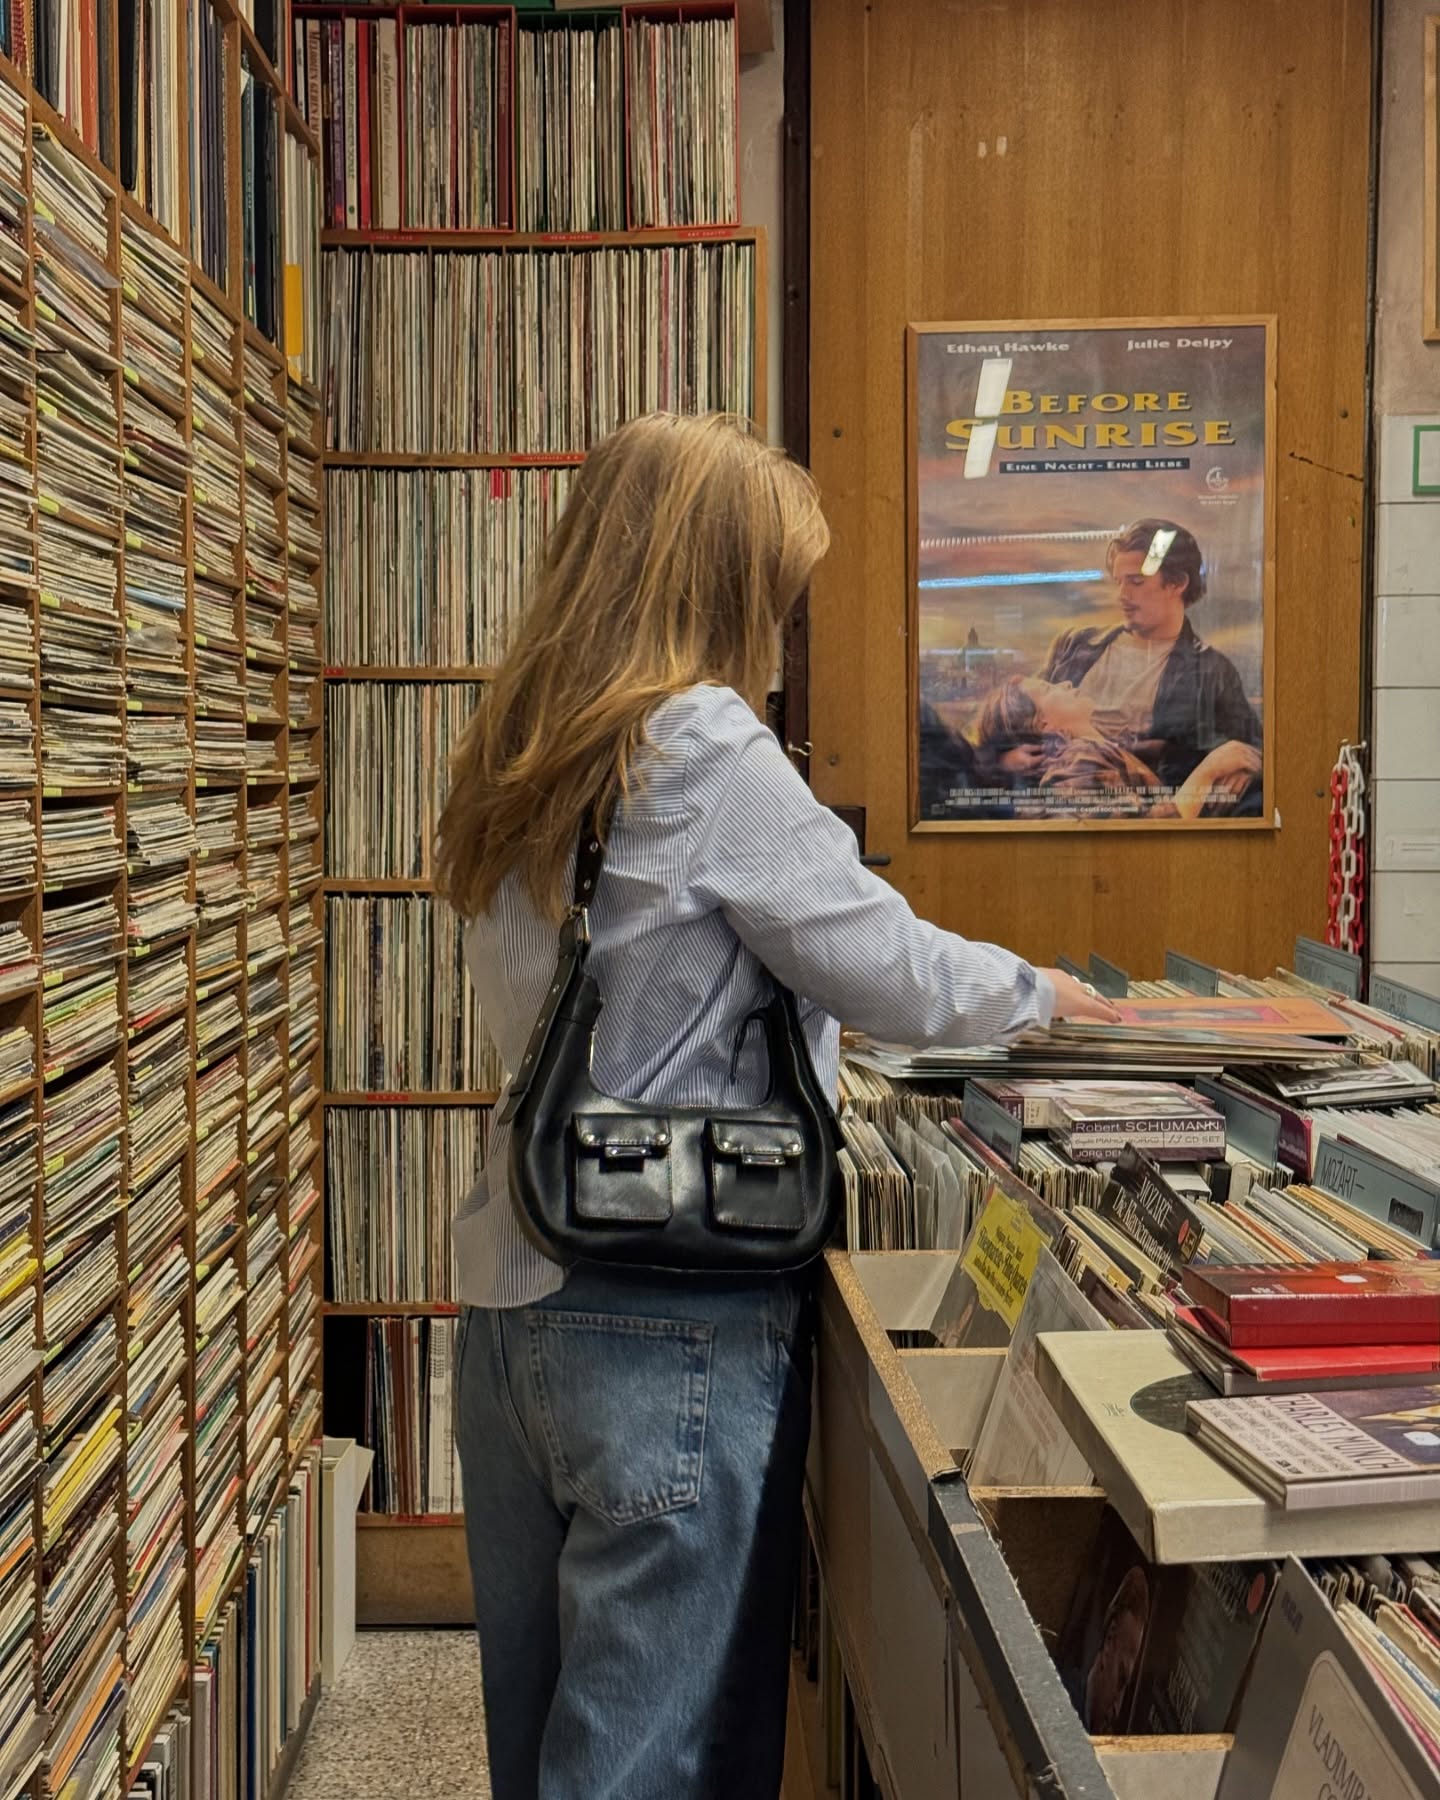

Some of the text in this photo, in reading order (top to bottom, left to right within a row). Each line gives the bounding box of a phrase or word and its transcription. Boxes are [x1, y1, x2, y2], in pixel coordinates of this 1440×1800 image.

[946, 342, 1070, 353] Ethan Hawke
[1127, 337, 1233, 351] Julie Delpy
[1000, 389, 1192, 415] BEFORE
[1075, 1120, 1221, 1133] Robert SCHUMANN
[1184, 1136, 1200, 1144] CD
[1203, 1135, 1221, 1144] SET
[1138, 1176, 1173, 1228] MOZART
[1266, 1393, 1354, 1434] CHARLES
